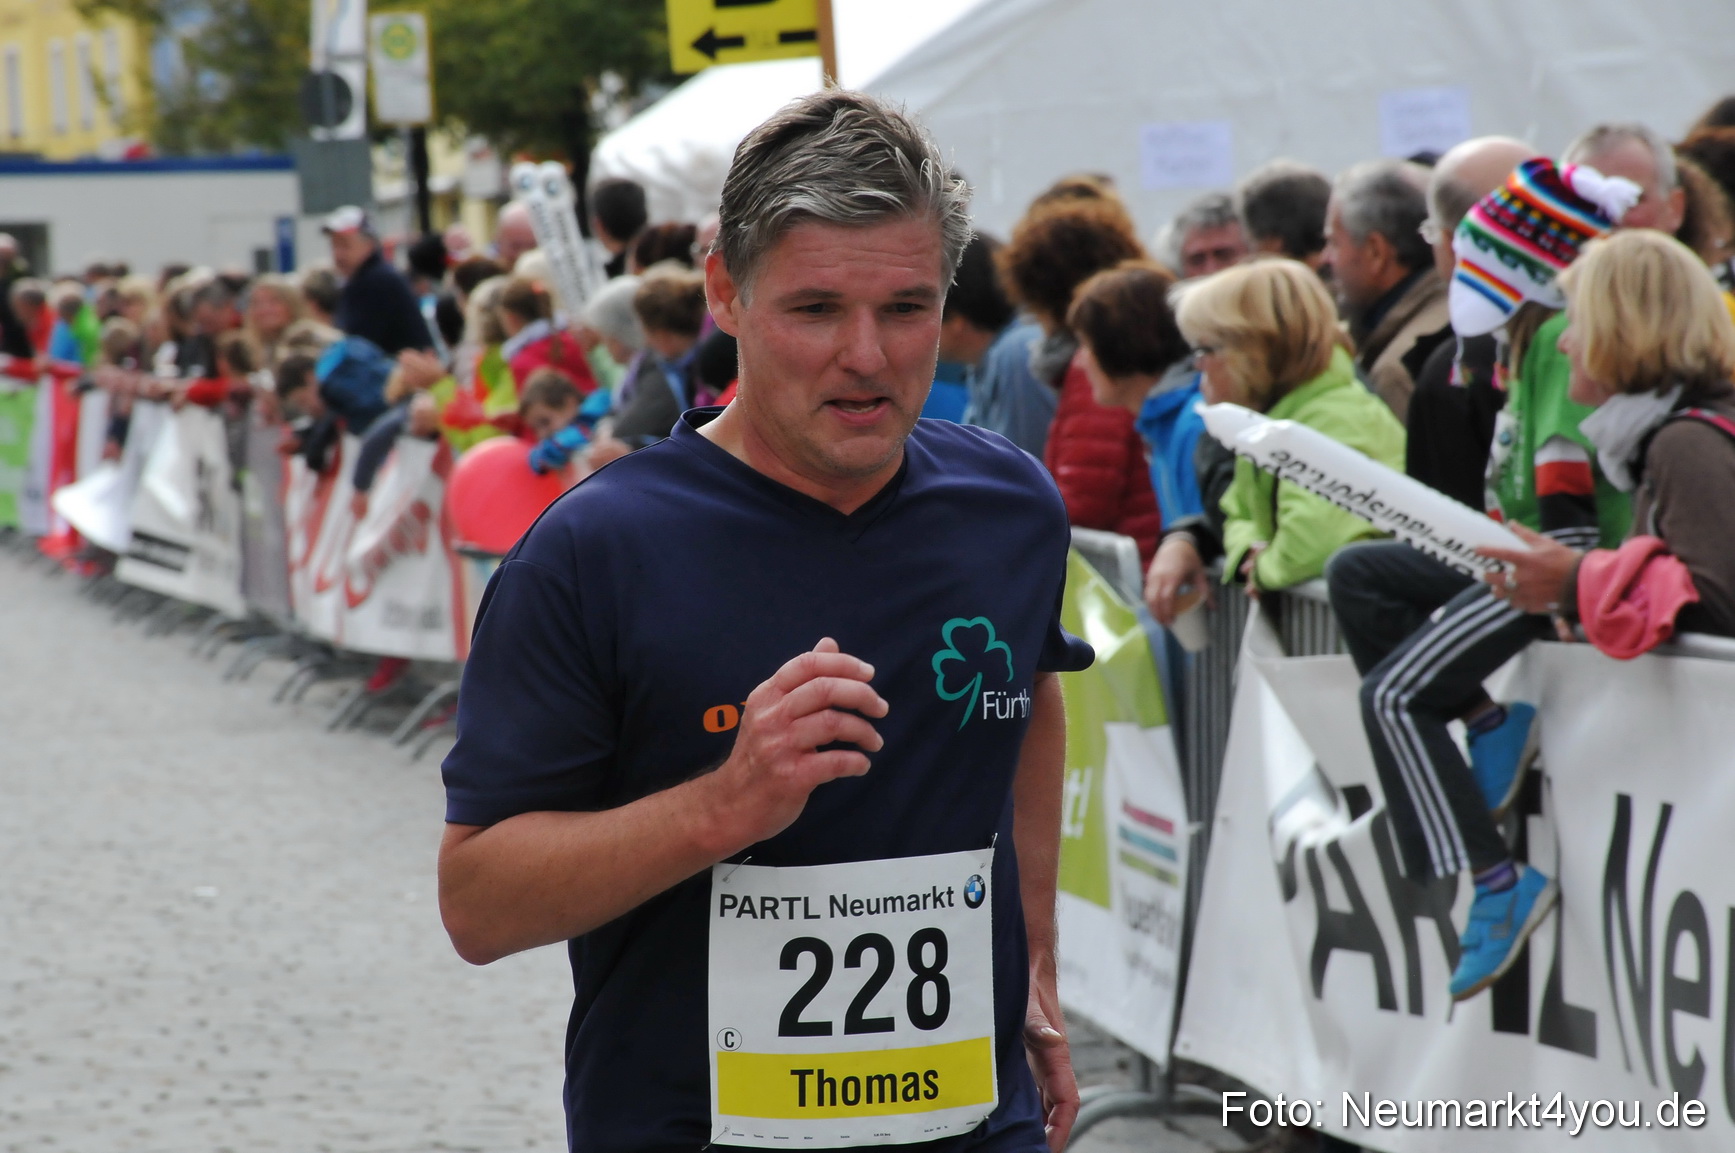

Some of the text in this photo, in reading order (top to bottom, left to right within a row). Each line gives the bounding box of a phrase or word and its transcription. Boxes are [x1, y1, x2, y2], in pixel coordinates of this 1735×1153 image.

[983, 688, 1031, 720] Fürth
[719, 886, 954, 920] PARTL Neumarkt
[1603, 792, 1735, 1126] Ne
[778, 927, 951, 1037] 228
[724, 1031, 735, 1048] C
[790, 1069, 939, 1108] Thomas
